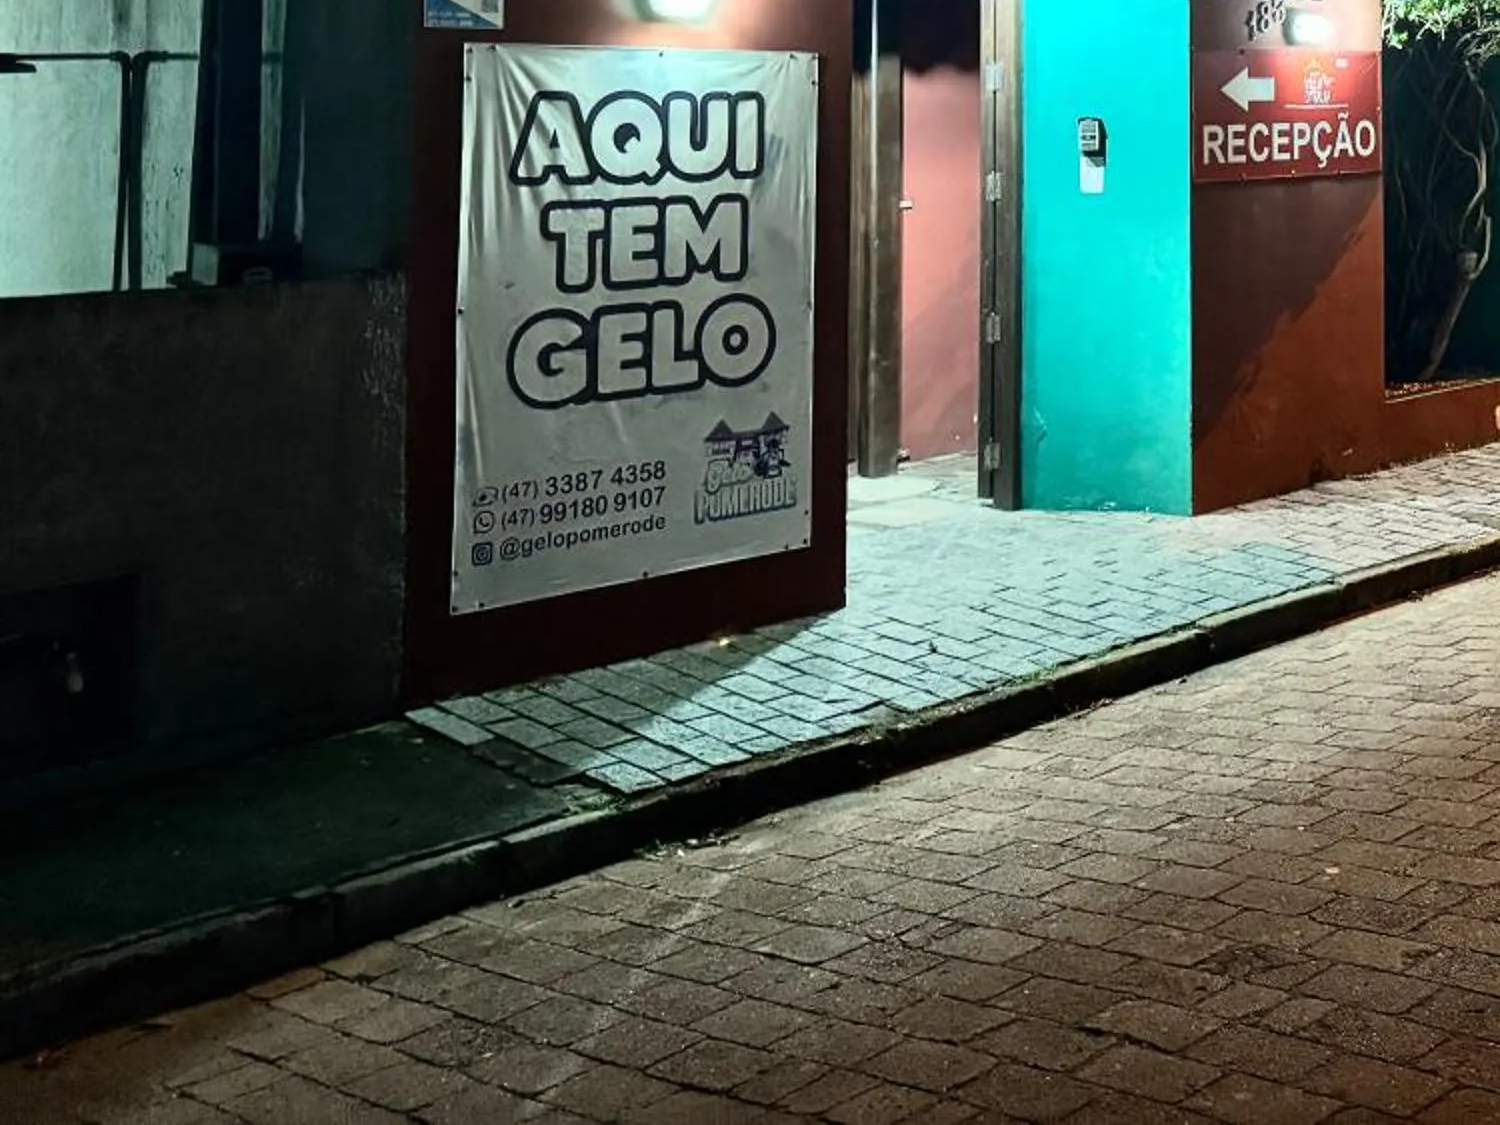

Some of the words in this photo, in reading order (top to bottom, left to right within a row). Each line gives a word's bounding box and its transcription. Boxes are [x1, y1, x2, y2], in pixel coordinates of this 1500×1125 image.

[511, 90, 766, 185] AQUI
[1203, 111, 1376, 168] RECEPÇÃO
[541, 194, 749, 293] TEM
[507, 293, 776, 409] GELO
[501, 508, 535, 531] (47)
[540, 495, 608, 524] 99180
[613, 486, 666, 513] 9107
[502, 480, 538, 503] (47)
[545, 470, 604, 496] 3387
[611, 460, 667, 485] 4358
[500, 514, 666, 561] @gelopomerode
